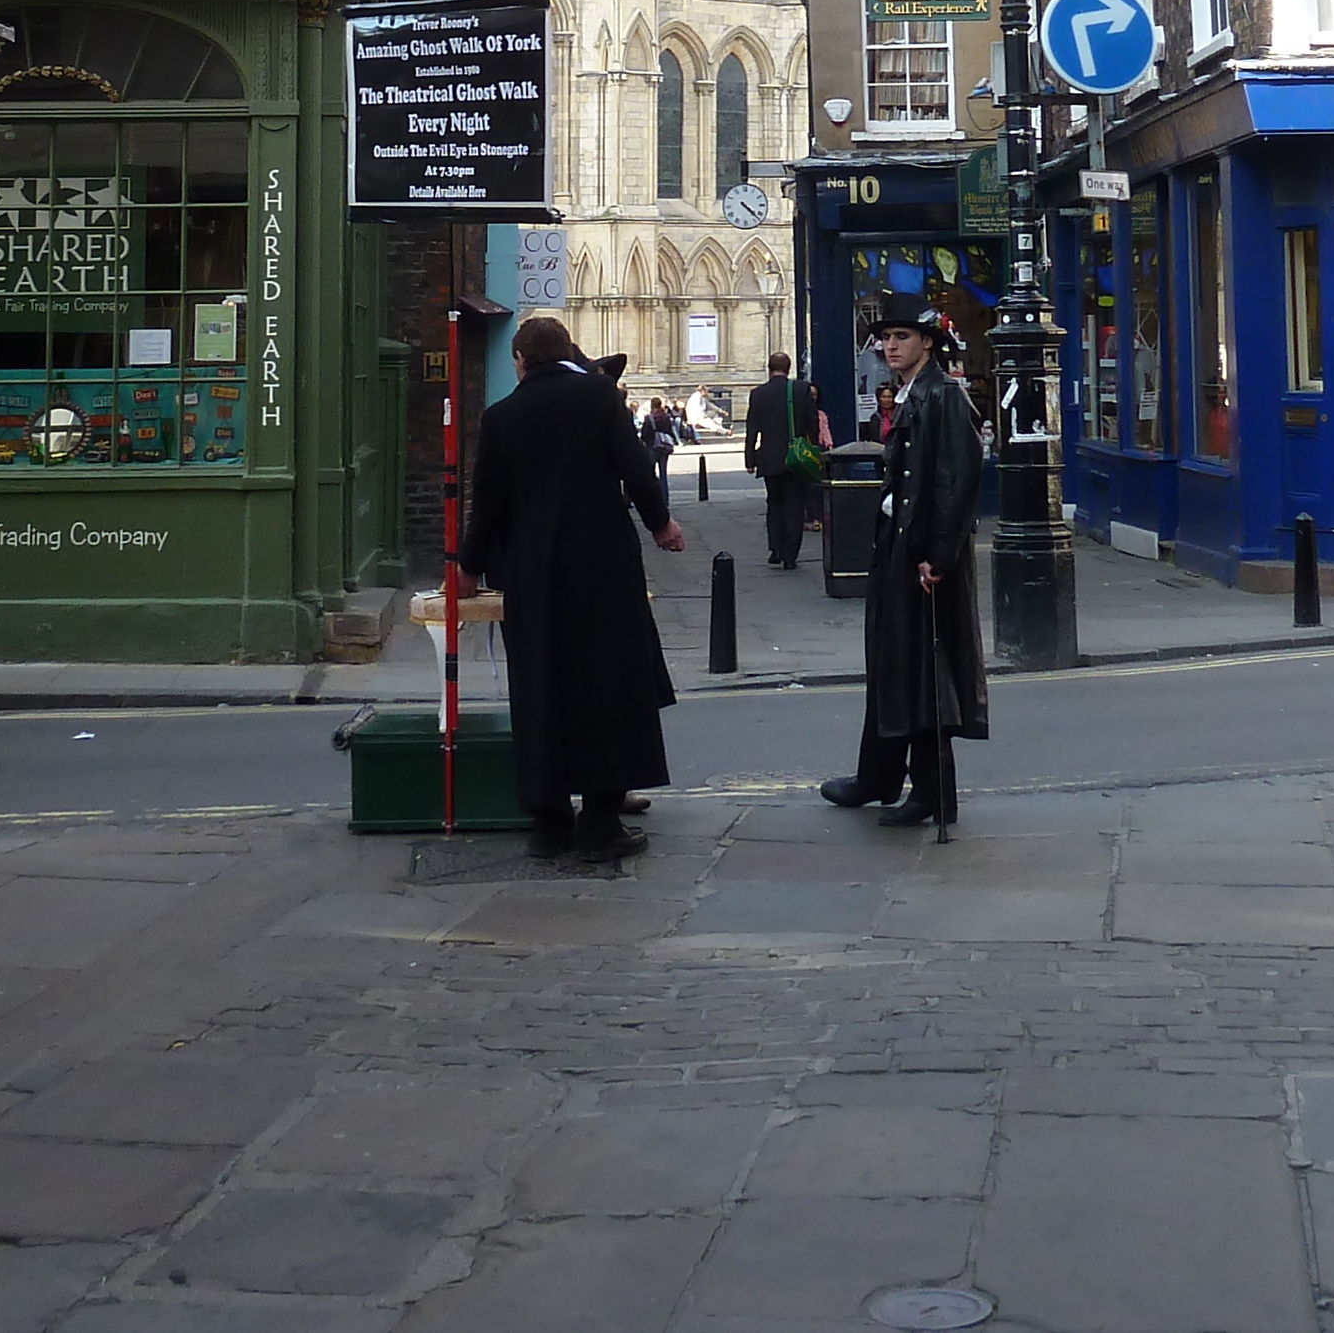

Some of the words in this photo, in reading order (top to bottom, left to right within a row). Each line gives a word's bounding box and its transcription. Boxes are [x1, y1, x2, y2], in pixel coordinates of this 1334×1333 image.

[885, 2, 909, 14] Rail
[912, 2, 974, 17] Experience
[356, 41, 408, 61] Amazing
[410, 39, 447, 56] Ghost
[449, 36, 484, 54] Walk
[485, 35, 503, 53] Of
[504, 34, 542, 51] York
[359, 87, 384, 105] The
[385, 84, 454, 103] Theatrical
[456, 83, 497, 102] Ghost
[498, 81, 539, 100] Walk
[408, 113, 448, 135] Every
[449, 112, 490, 135] Night
[373, 145, 409, 158] Outside
[410, 145, 428, 157] The
[429, 144, 448, 156] Evil
[449, 145, 467, 159] Eye
[468, 144, 479, 156] in
[480, 143, 529, 159] Stonegate
[424, 165, 438, 176] At
[468, 185, 487, 198] Here
[849, 175, 880, 204] 10
[1086, 177, 1105, 190] One
[263, 168, 284, 302] SHARED
[5, 298, 25, 312] Fair
[28, 299, 70, 314] Traing
[261, 316, 282, 427] EARTH
[70, 521, 169, 551] Company
